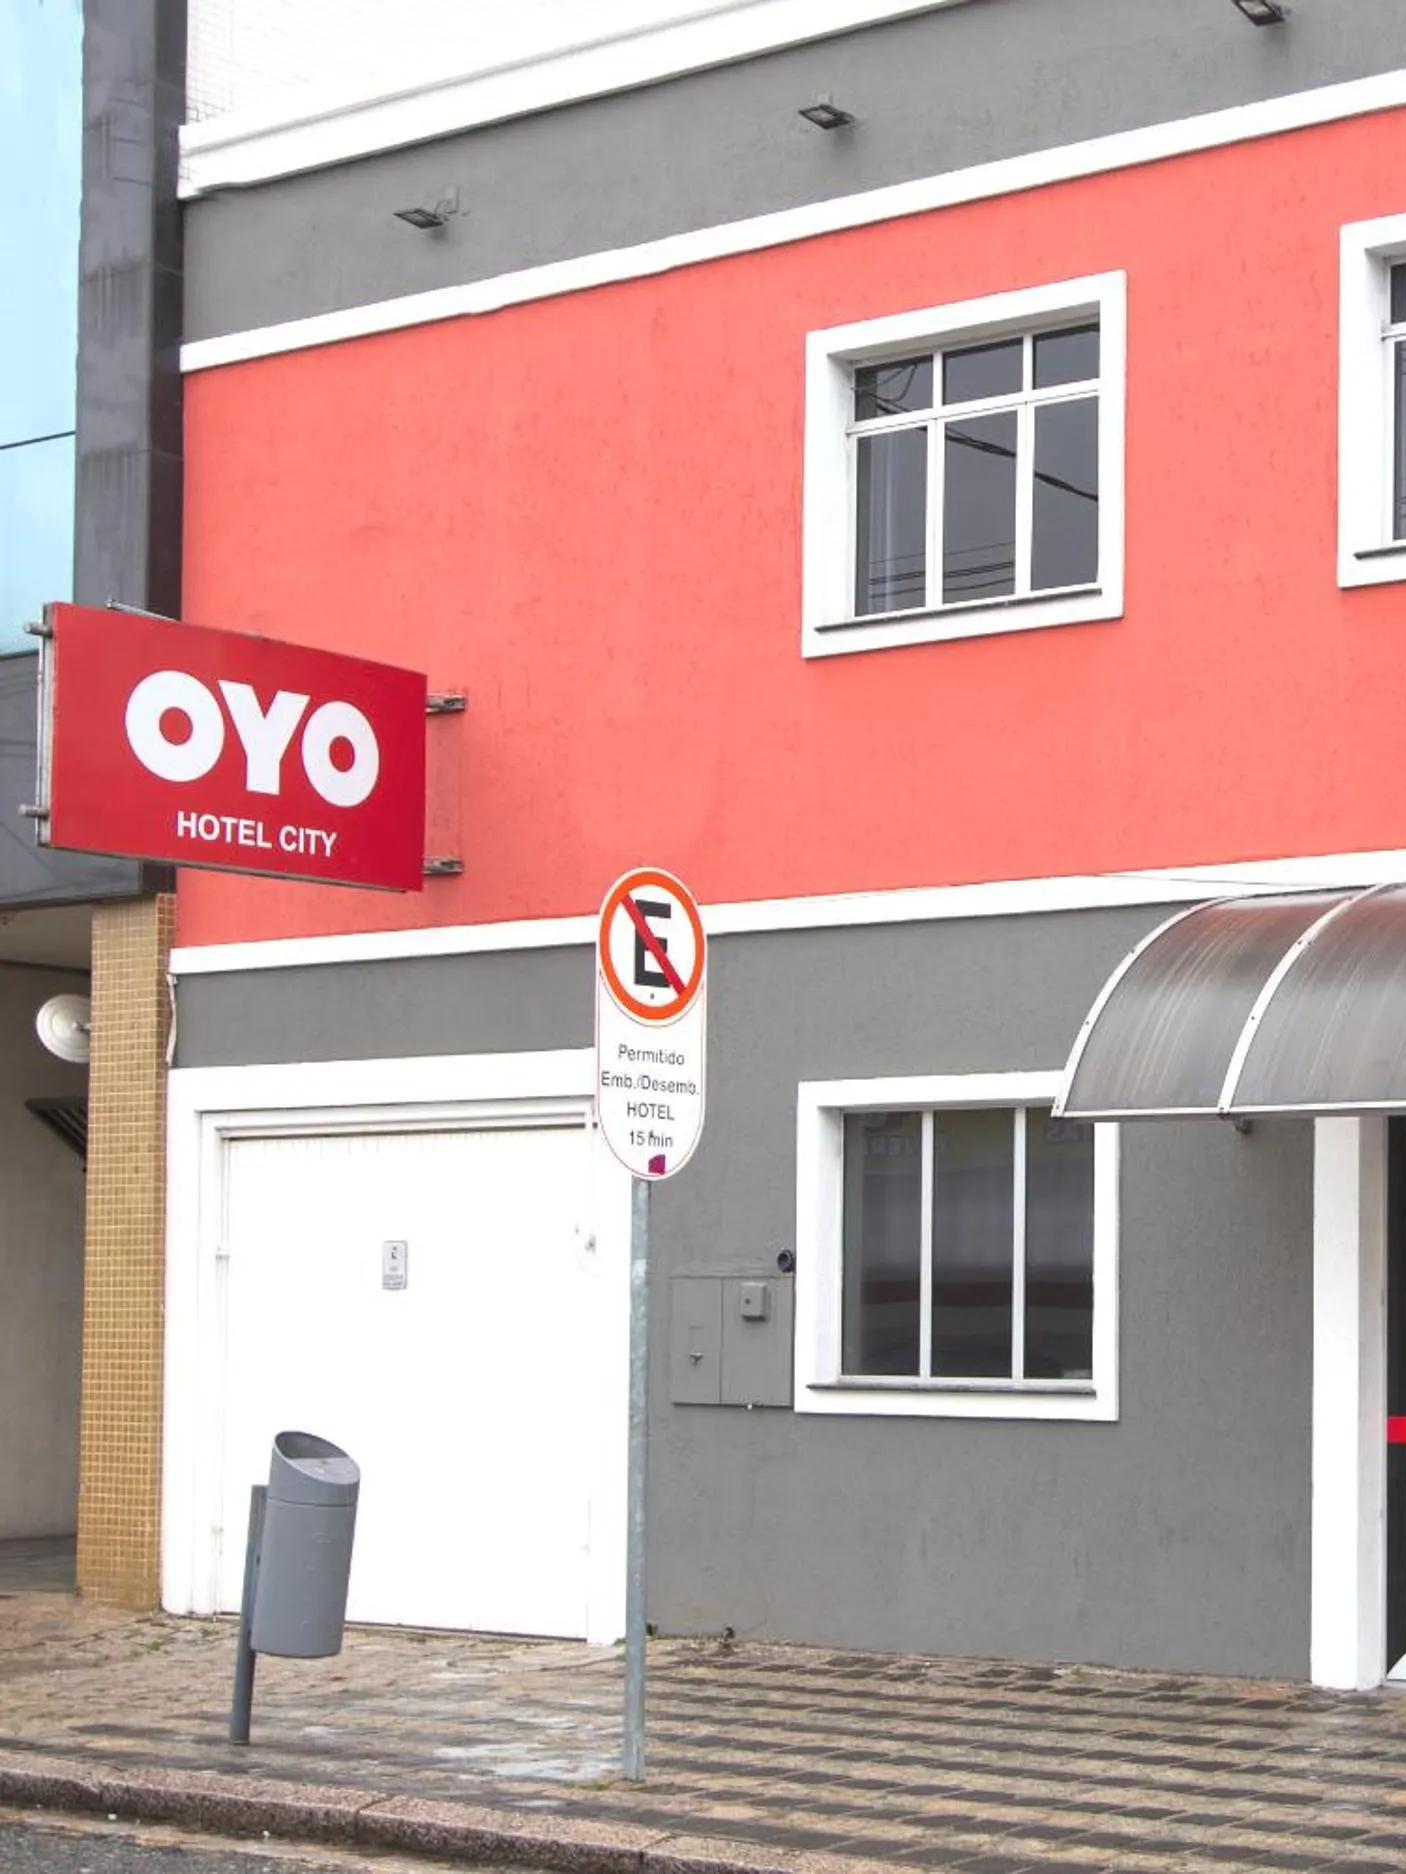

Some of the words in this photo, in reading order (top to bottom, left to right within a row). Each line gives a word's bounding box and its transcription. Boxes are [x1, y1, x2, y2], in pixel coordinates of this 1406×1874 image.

[124, 669, 380, 808] OYO
[176, 810, 273, 849] HOTEL
[278, 825, 338, 858] CITY
[617, 1043, 685, 1066] Permitido
[626, 1100, 676, 1121] HOTEL
[629, 1129, 646, 1146] 15
[648, 1131, 674, 1148] min
